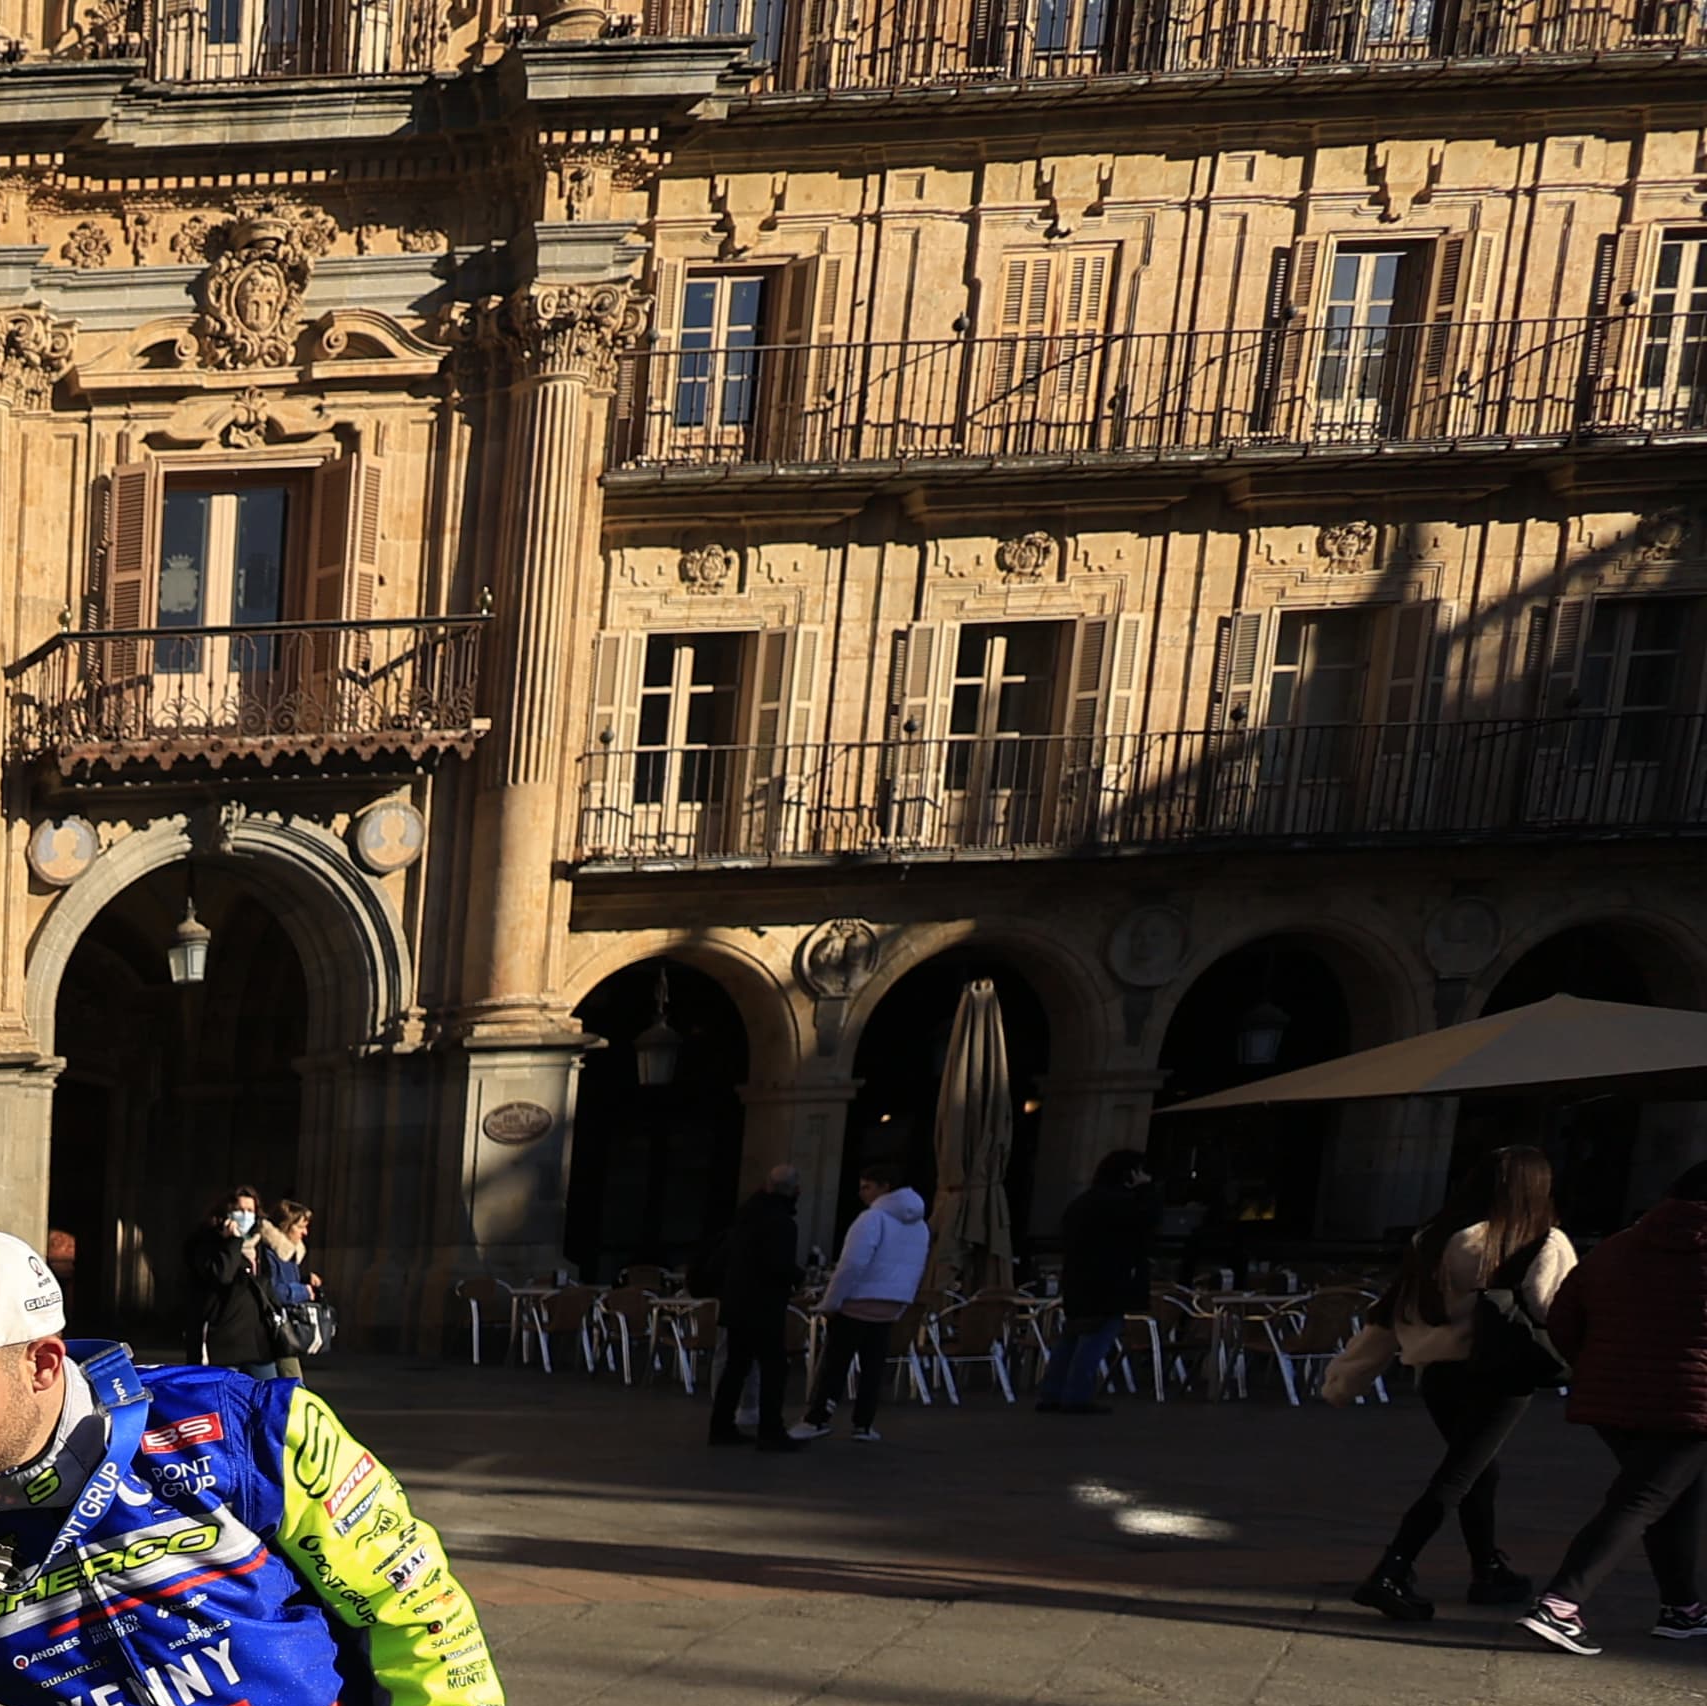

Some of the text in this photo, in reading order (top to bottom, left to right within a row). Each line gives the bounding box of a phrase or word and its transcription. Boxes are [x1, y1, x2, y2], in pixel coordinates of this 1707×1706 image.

[143, 1416, 213, 1448] BS
[152, 1455, 213, 1482] PONT
[79, 1461, 120, 1520] GRUP
[161, 1474, 217, 1499] GRUP
[330, 1458, 373, 1514] MOTUL
[310, 1553, 379, 1626] PONT GRUP
[29, 1636, 81, 1666] ANDRÉS
[41, 1659, 101, 1690] GUIJUELO
